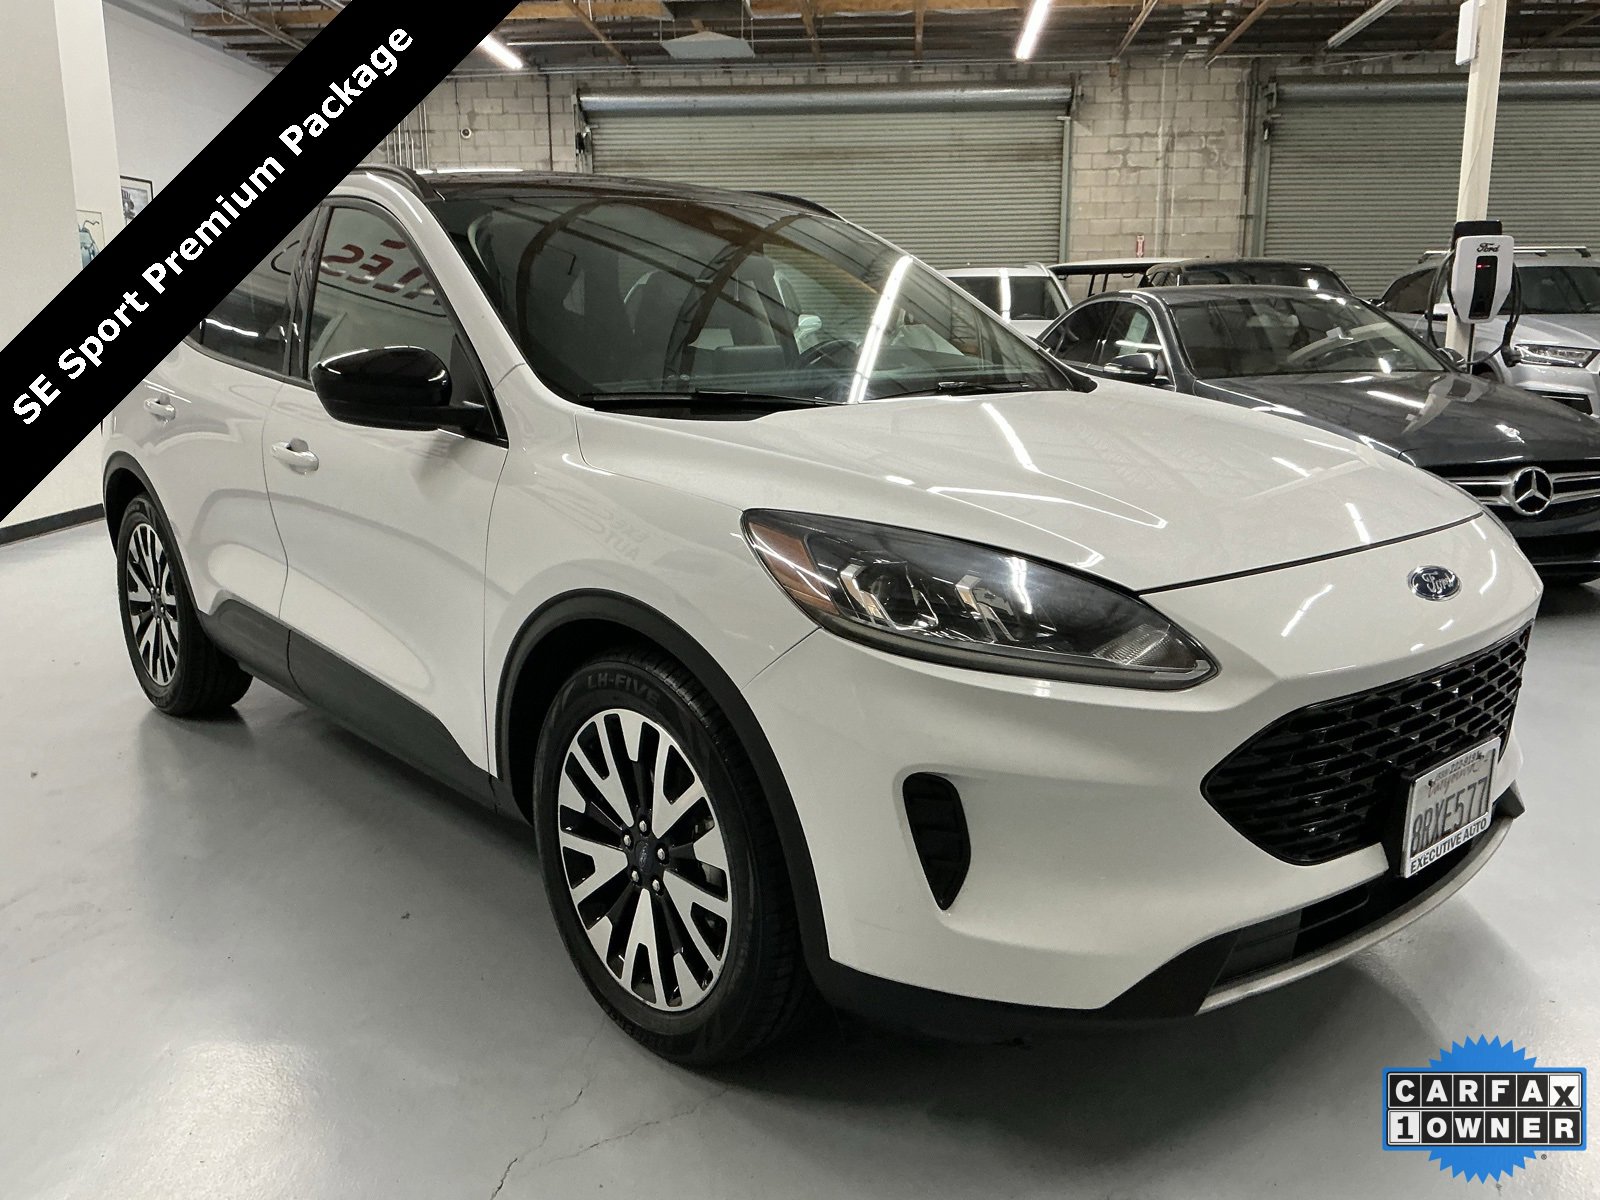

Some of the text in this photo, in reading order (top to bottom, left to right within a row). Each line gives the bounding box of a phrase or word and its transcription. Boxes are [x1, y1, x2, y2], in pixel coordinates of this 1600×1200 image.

[1476, 242, 1501, 252] Ford
[587, 672, 660, 704] LH-FIVE
[1410, 776, 1488, 856] 8RXE577
[1410, 817, 1487, 875] EXECUTIVE AUTO
